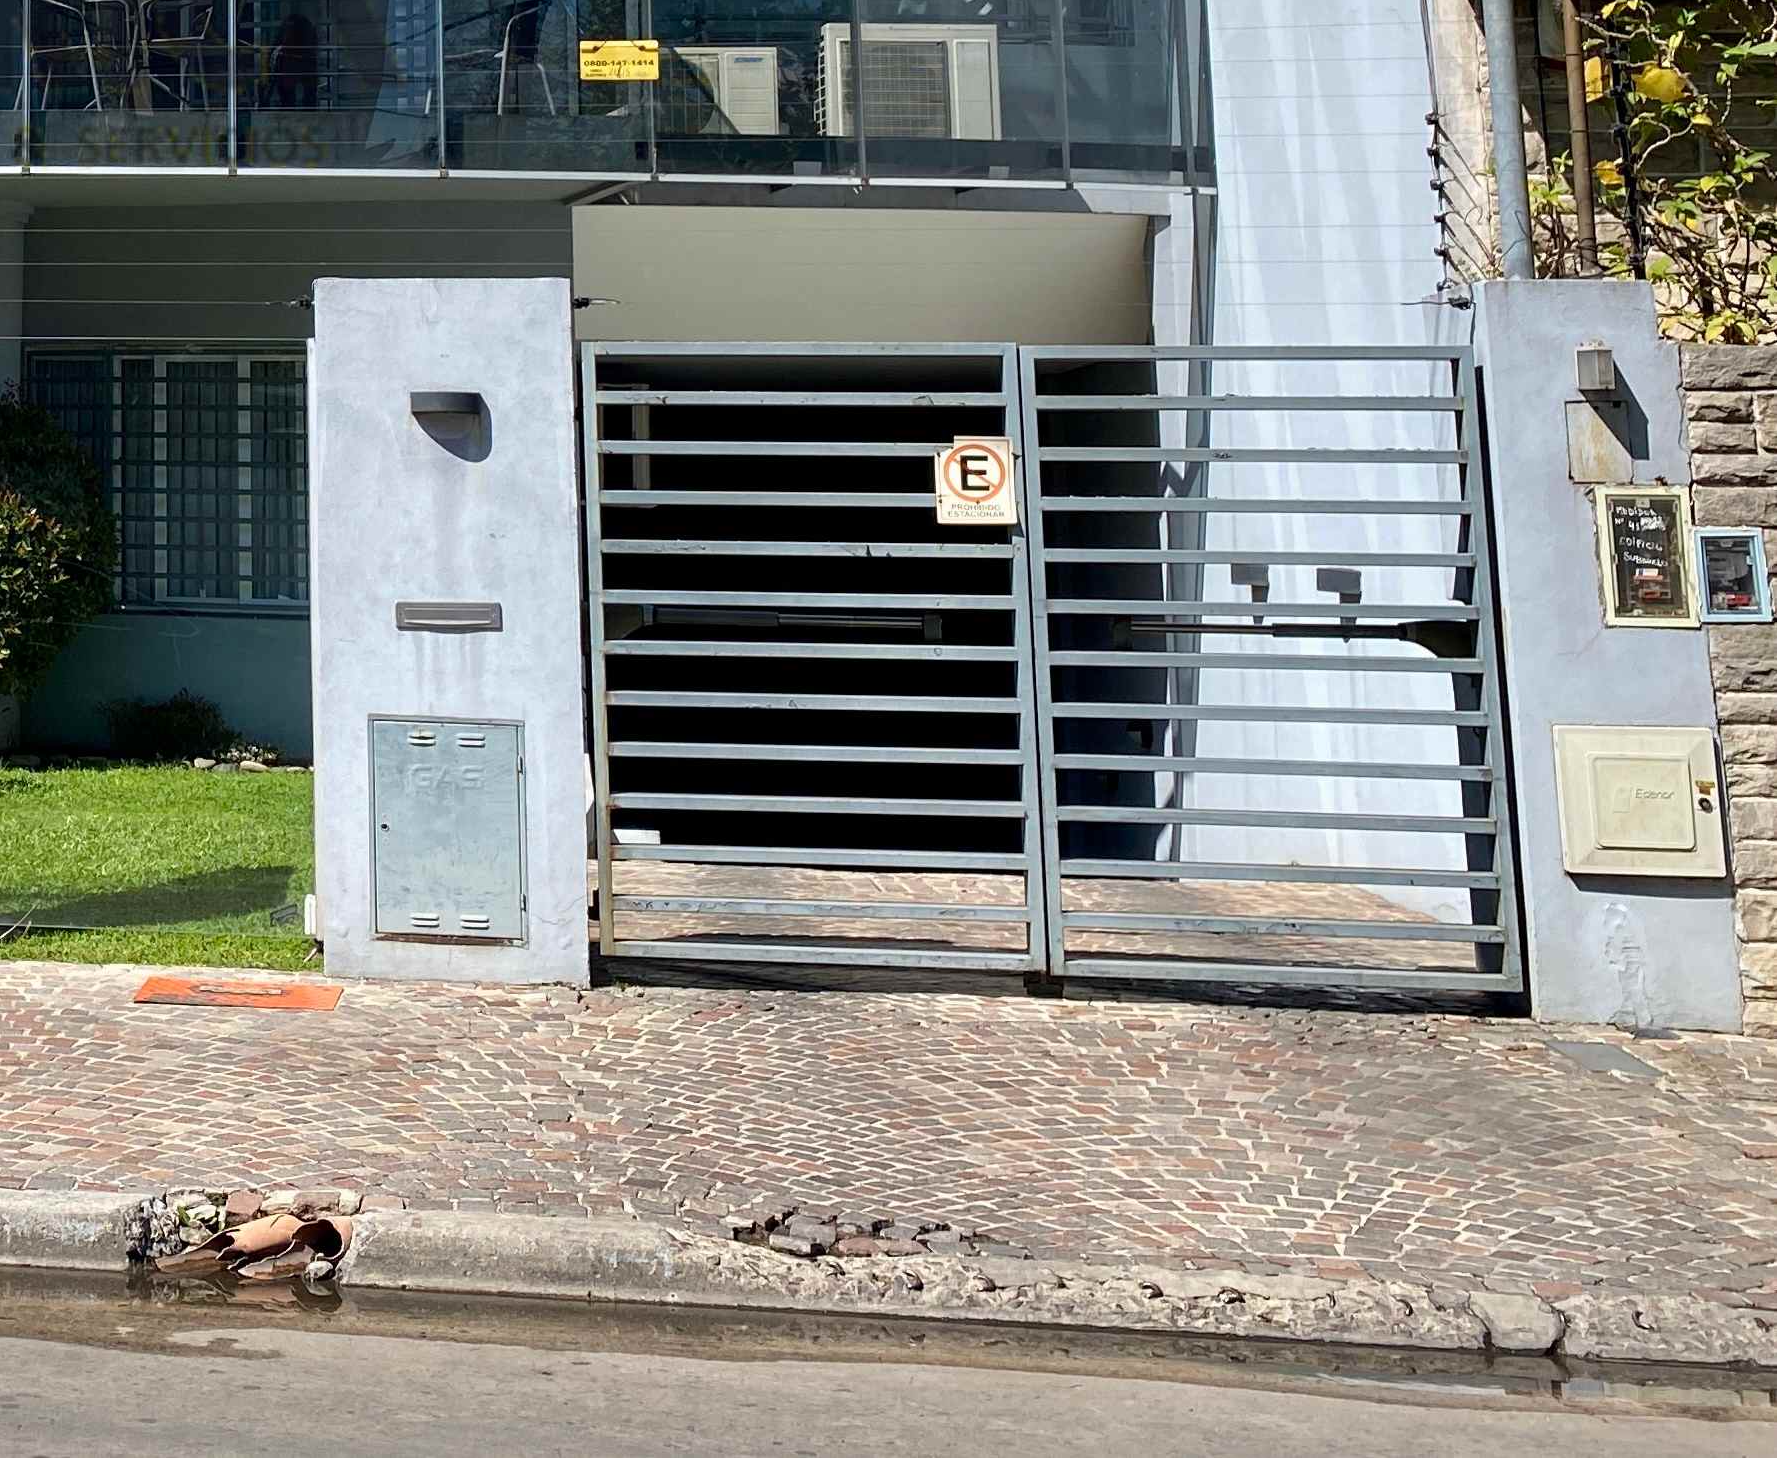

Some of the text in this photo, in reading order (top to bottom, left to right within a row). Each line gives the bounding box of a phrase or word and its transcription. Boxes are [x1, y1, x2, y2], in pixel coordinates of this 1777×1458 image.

[959, 454, 990, 492] E
[947, 510, 1005, 518] ESTACIONAR
[951, 503, 1001, 511] PROHIBIDO
[405, 763, 487, 791] GAS
